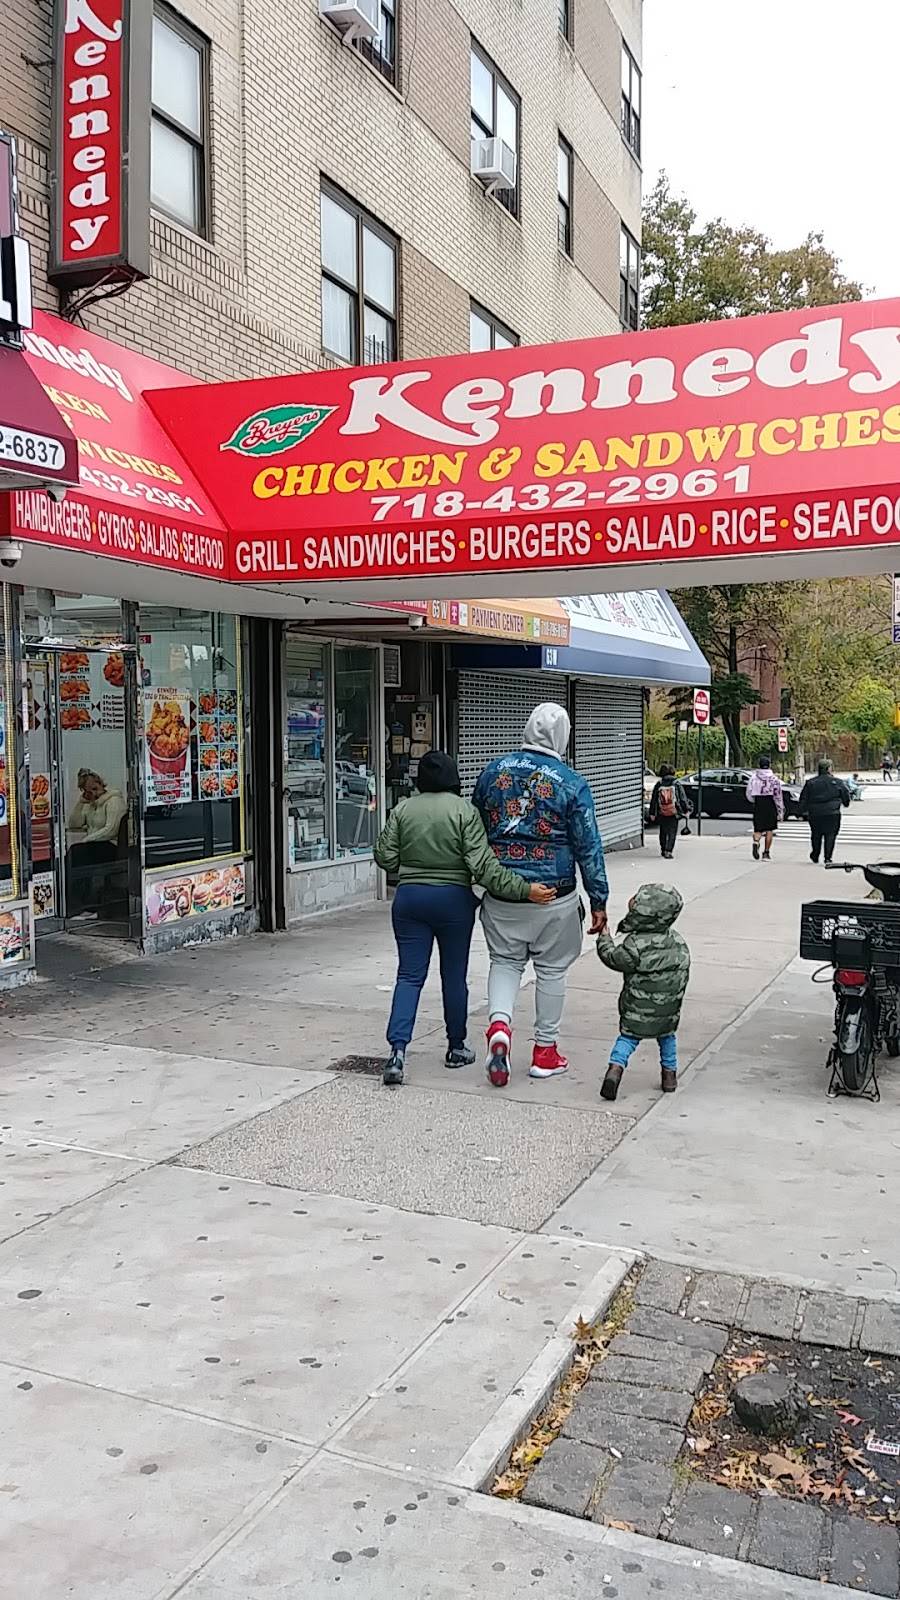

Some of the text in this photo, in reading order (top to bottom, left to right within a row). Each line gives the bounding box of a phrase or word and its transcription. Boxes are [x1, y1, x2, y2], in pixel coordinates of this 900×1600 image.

[339, 317, 900, 448] Kennedy
[240, 411, 320, 450] Breyers
[252, 404, 900, 499] CHICKEN & SANDWICHES
[15, 490, 224, 570] HAMBURGERS GYROS SALADS SEAFOOD
[370, 464, 750, 522] 718-432-2961
[235, 496, 900, 573] GRILL SANDWICHES BURGERS SALAD RICE SEAFO
[471, 602, 500, 630] PAYMENT
[502, 613, 525, 634] CENTER
